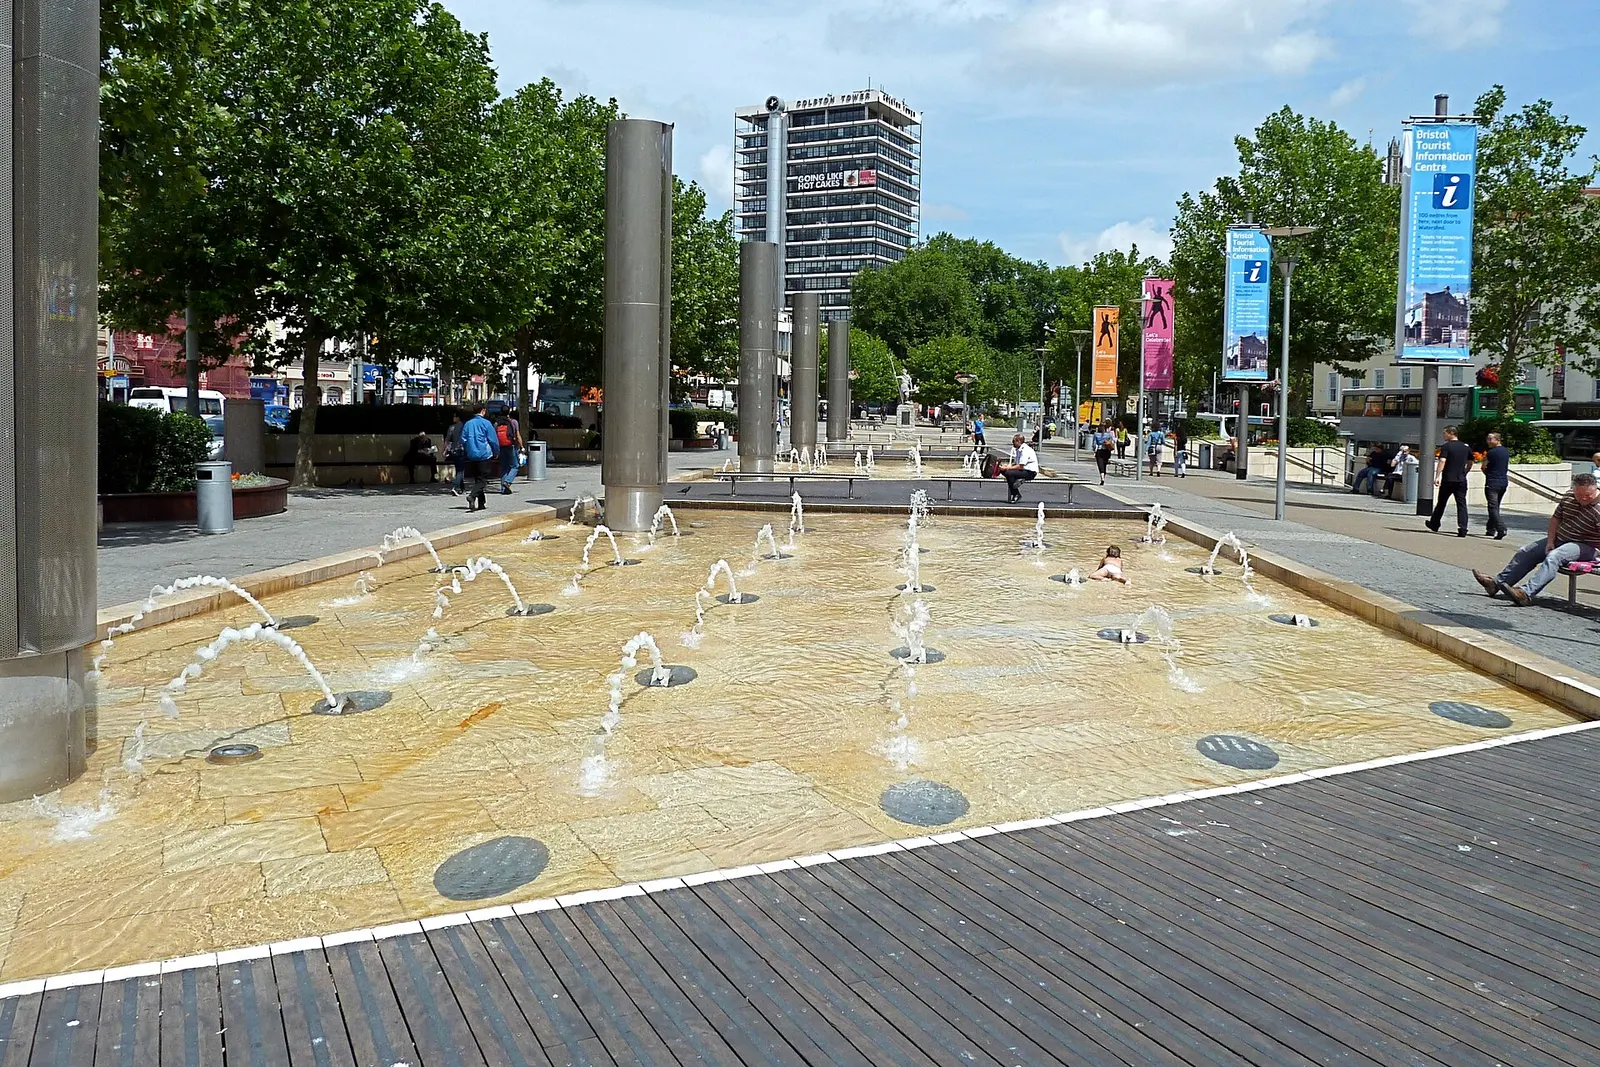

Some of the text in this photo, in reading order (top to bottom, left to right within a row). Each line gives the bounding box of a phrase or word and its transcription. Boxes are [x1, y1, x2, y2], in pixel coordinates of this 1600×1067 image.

[796, 92, 871, 108] COLSTON TOWER
[1416, 130, 1449, 139] Bristol
[1415, 141, 1451, 150] Tourist
[1415, 151, 1472, 161] Information
[1414, 162, 1447, 172] Centre
[798, 171, 843, 183] GOING LIKE
[798, 179, 840, 190] HOT CAKES
